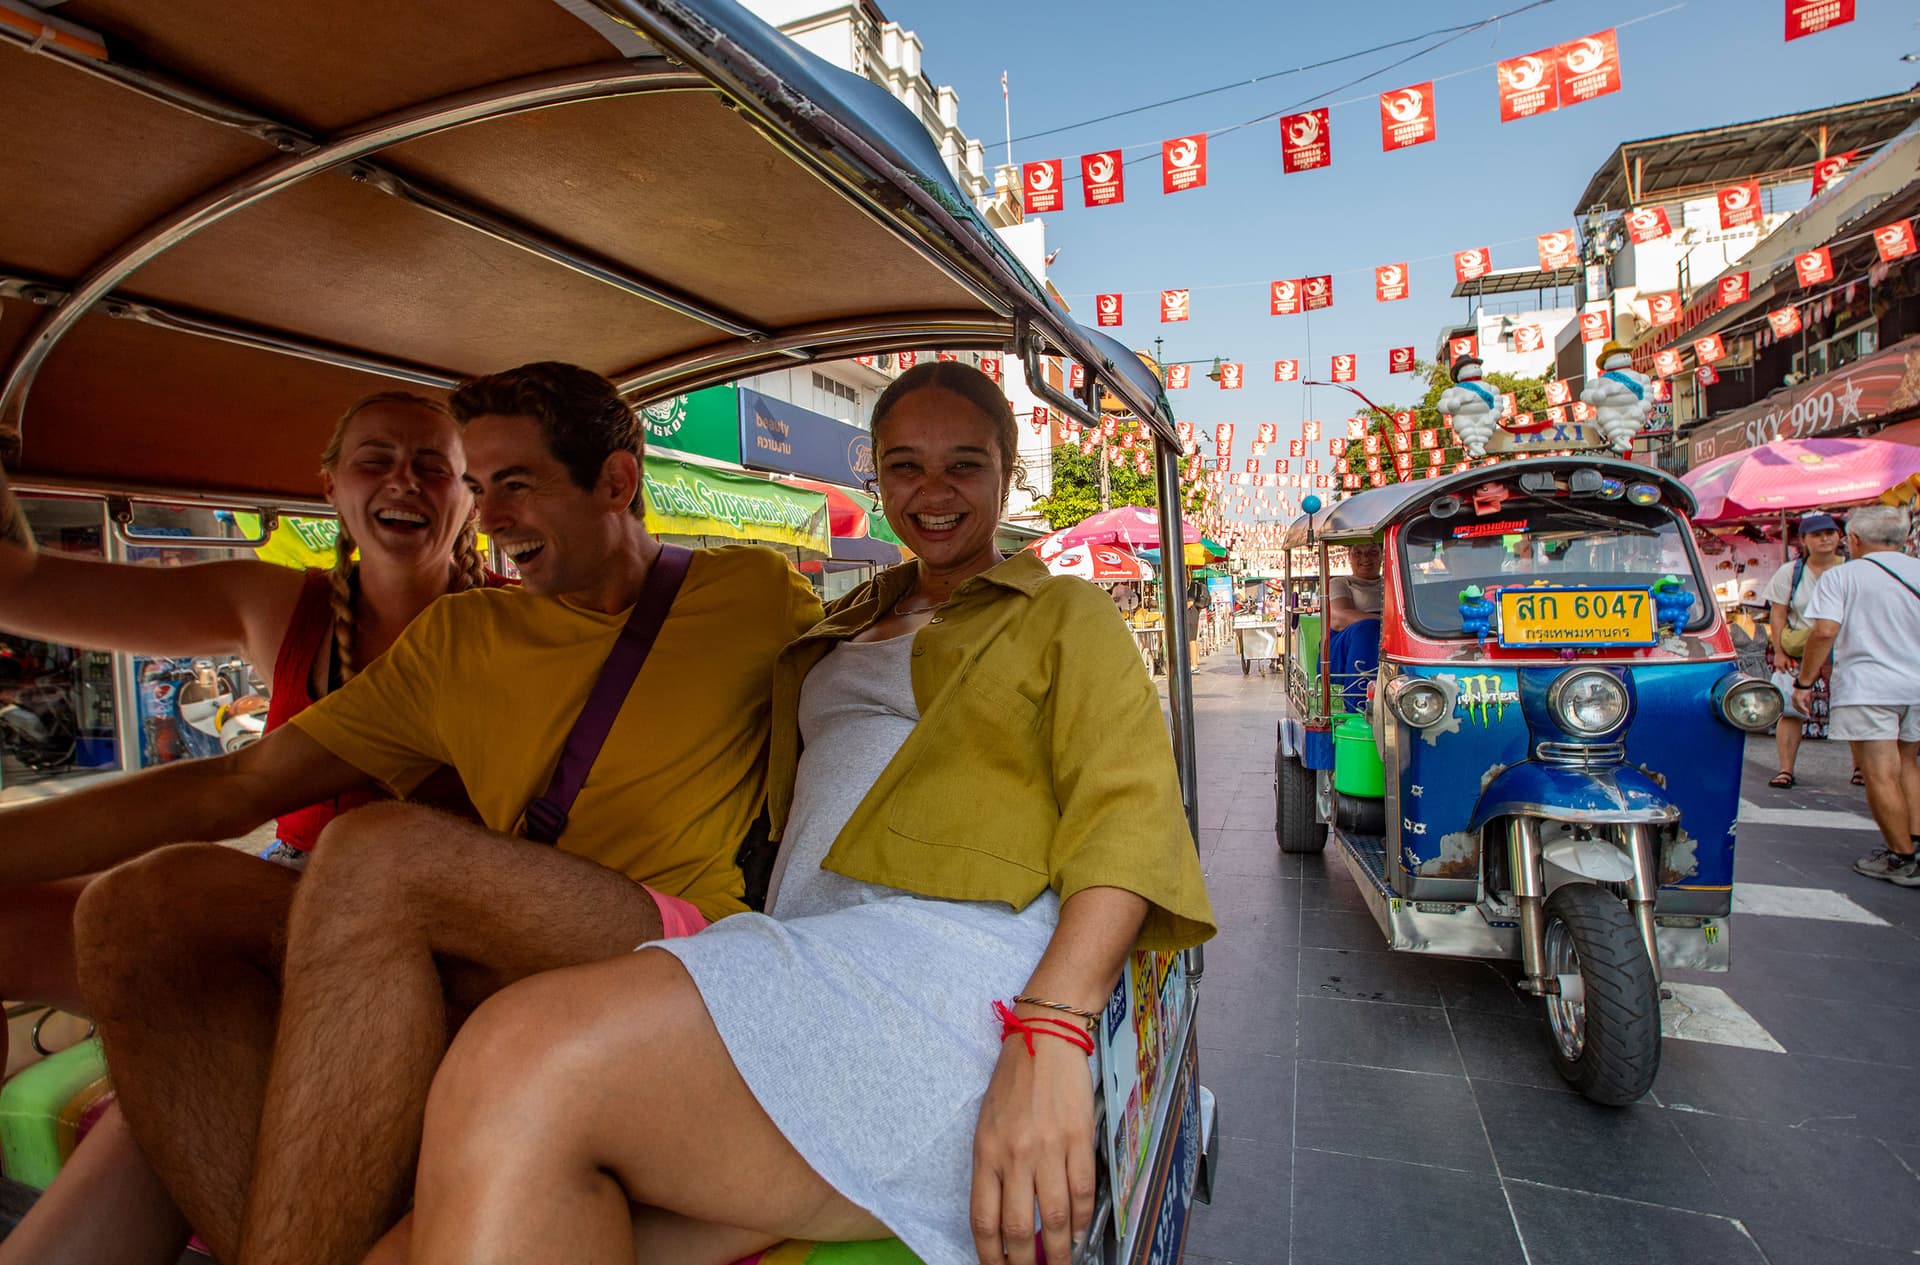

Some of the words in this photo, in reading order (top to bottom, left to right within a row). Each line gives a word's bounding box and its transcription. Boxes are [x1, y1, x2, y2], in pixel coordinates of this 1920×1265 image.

[755, 411, 790, 438] beauty
[1746, 409, 1784, 448] SKY
[1791, 392, 1834, 438] 999
[756, 436, 792, 455] ความงาม
[1696, 438, 1714, 459] LEO
[643, 473, 706, 517] Fresh
[695, 479, 785, 530] Sugarcane
[288, 516, 340, 551] Fre
[1516, 595, 1558, 620] สก
[1574, 594, 1644, 619] 6047
[1525, 627, 1631, 643] กรุงเทพมหานคร
